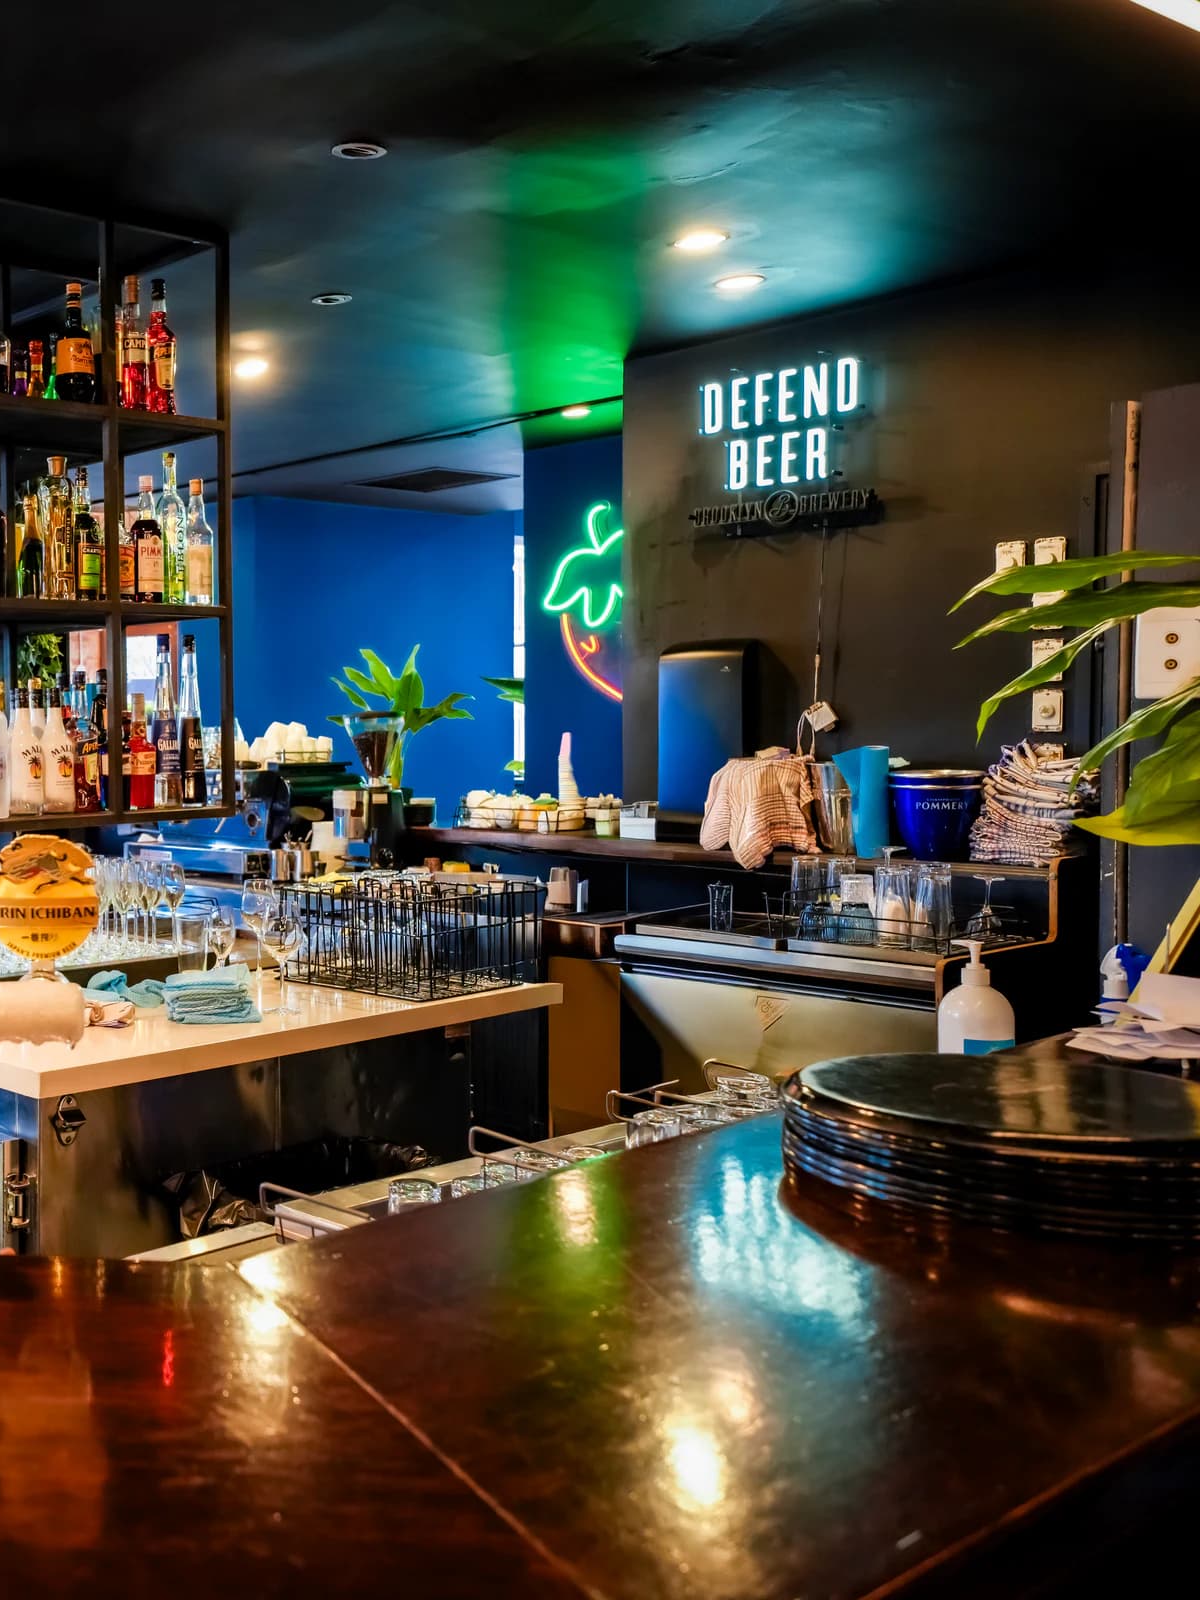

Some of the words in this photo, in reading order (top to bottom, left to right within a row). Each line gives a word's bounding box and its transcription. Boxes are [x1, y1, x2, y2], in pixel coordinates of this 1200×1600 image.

[703, 357, 859, 434] DEFEND
[728, 428, 827, 490] BEER
[694, 500, 765, 528] BROOKLYN
[799, 488, 869, 513] BREWERY
[915, 801, 969, 810] POMMERY
[31, 906, 96, 919] ICHIBAN
